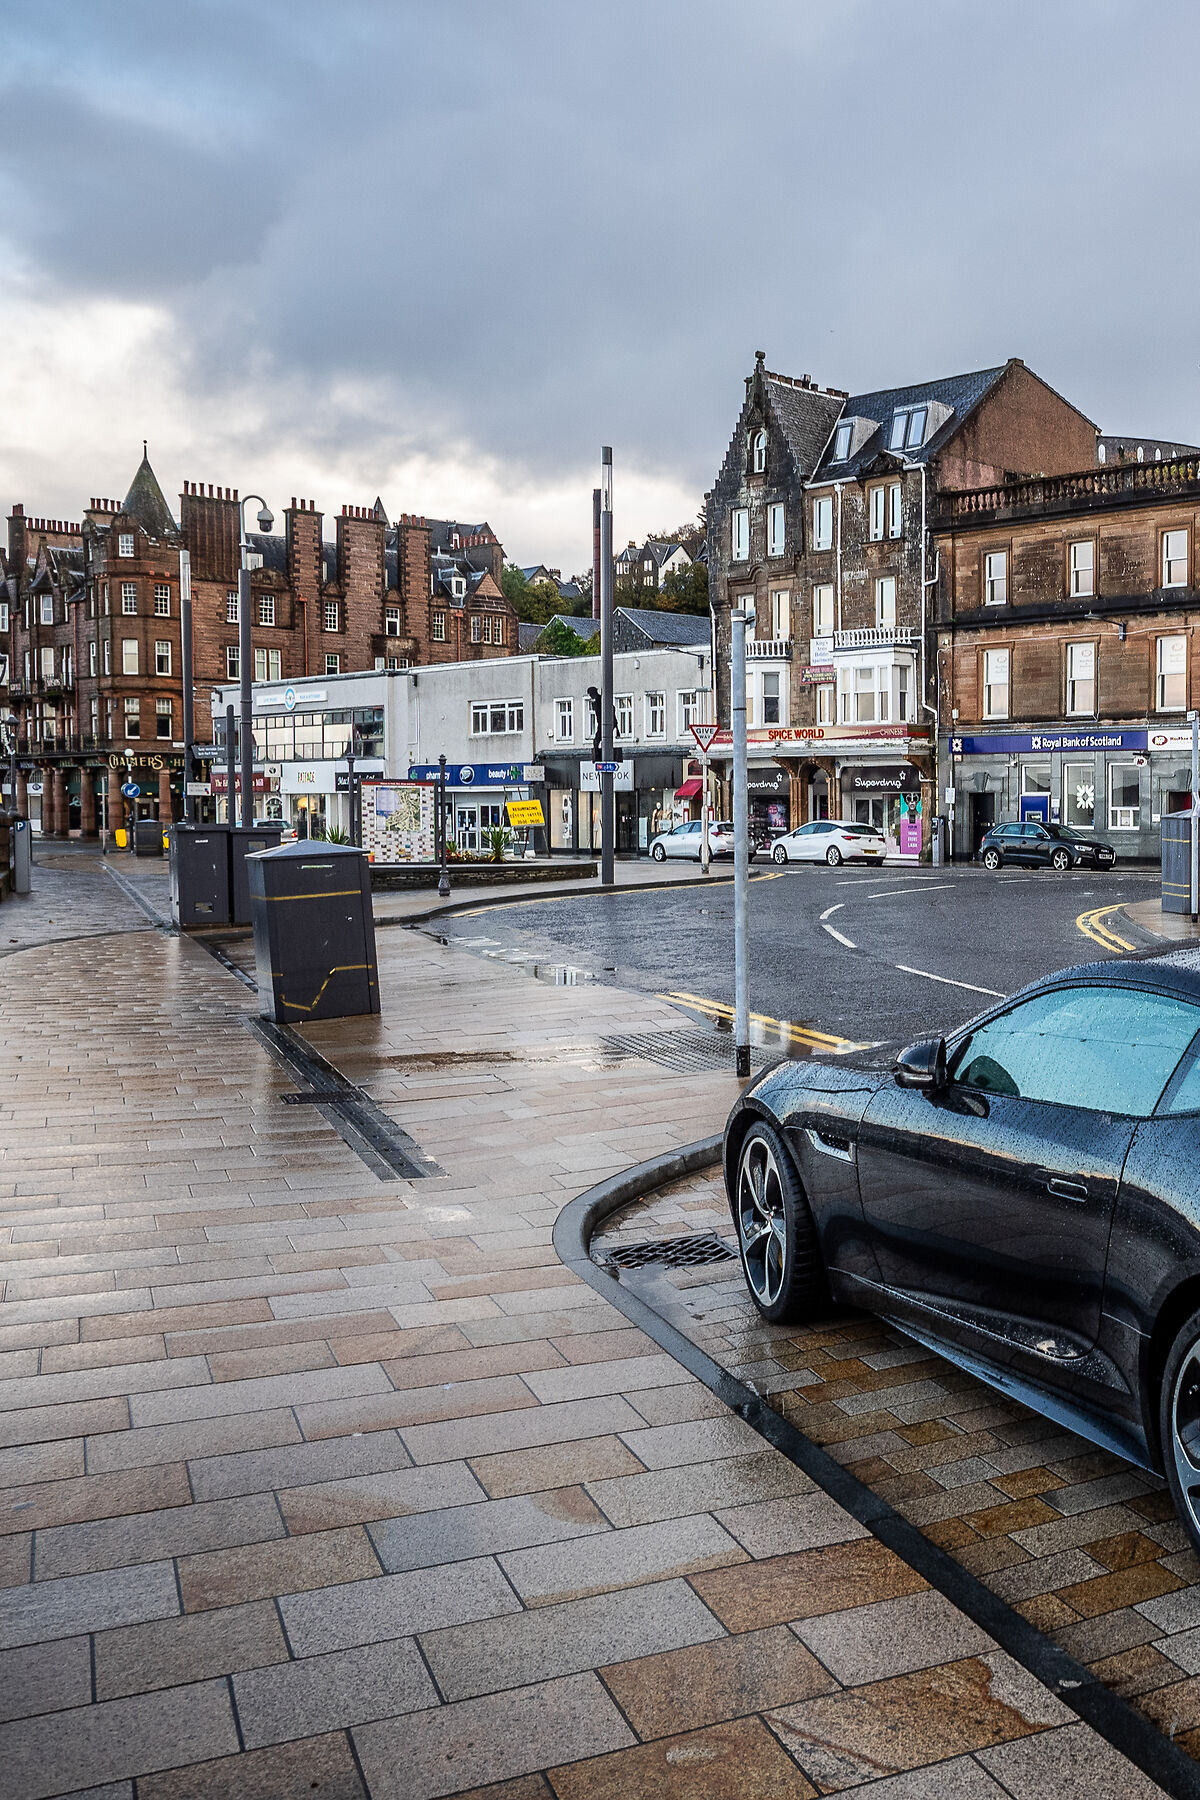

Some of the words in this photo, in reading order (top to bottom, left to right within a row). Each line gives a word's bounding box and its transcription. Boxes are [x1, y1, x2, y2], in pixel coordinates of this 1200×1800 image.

[768, 729, 793, 740] SPICE
[794, 728, 825, 740] WORLD
[1042, 737, 1062, 751] Royal
[1062, 737, 1080, 747] Bank
[1080, 736, 1088, 747] of
[1088, 735, 1122, 746] Scotland
[488, 768, 507, 780] beauty
[747, 779, 780, 790] perdrug
[855, 776, 902, 789] Superdrug
